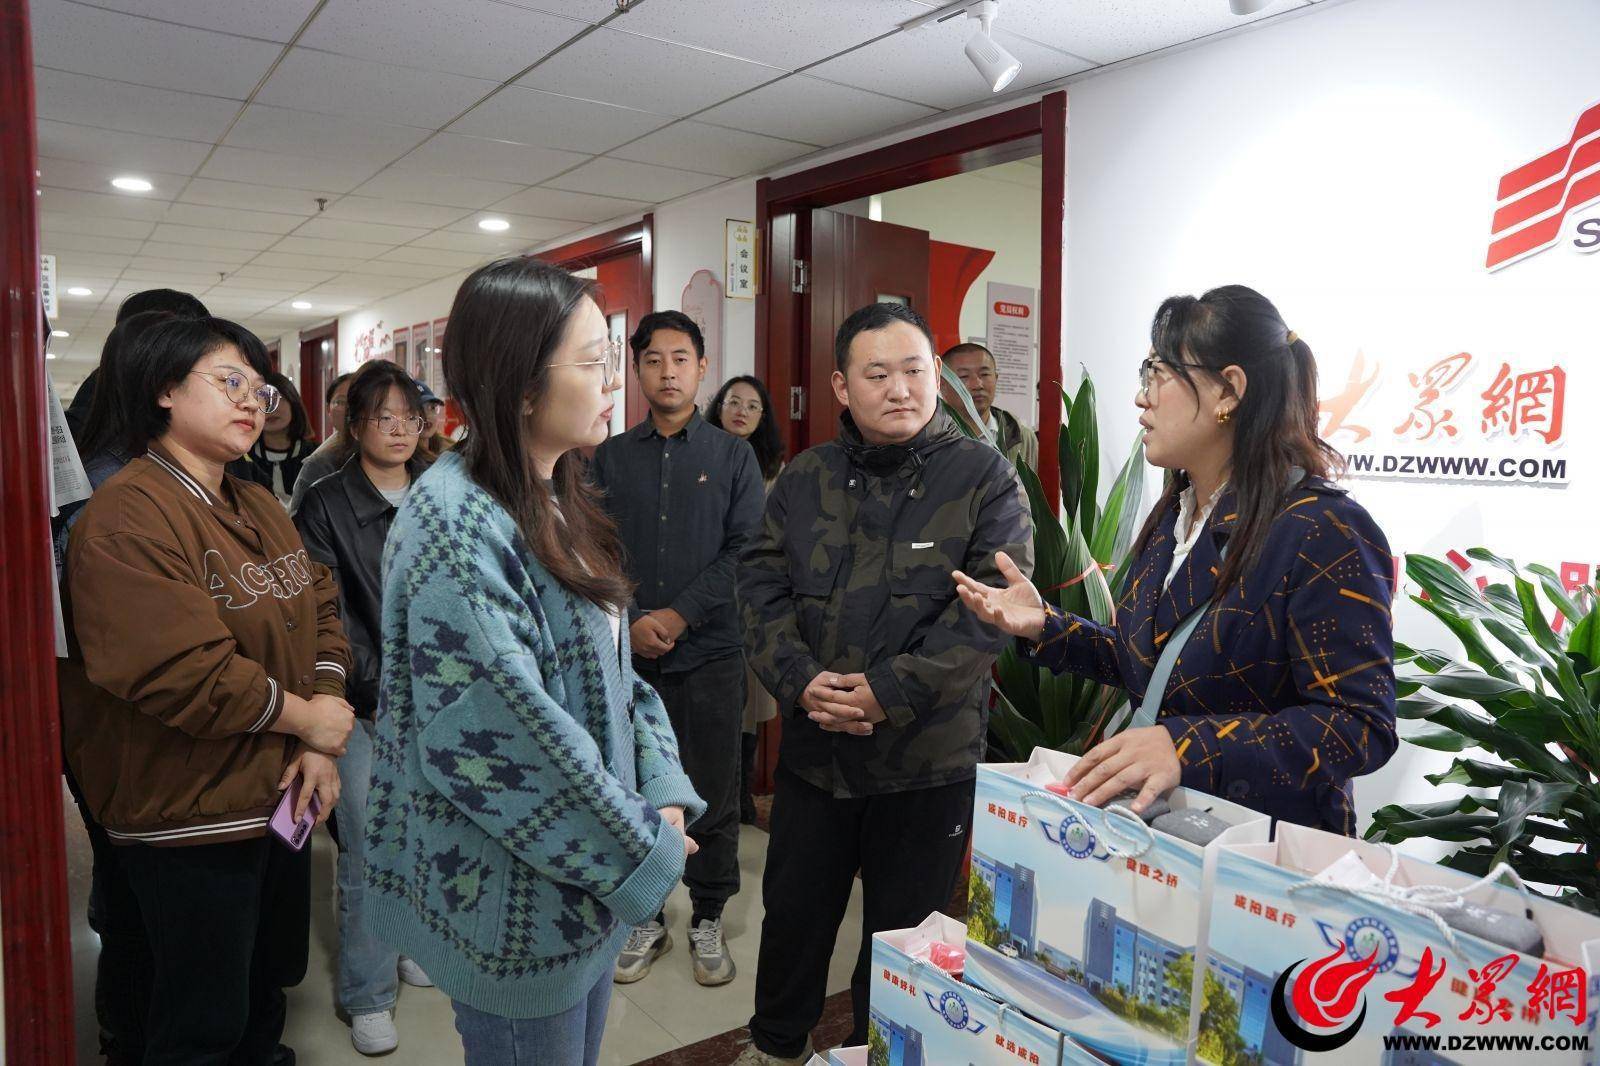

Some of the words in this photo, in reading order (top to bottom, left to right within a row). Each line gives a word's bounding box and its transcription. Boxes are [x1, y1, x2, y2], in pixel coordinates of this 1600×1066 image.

[740, 249, 748, 288] 会议室
[1126, 857, 1178, 888] 健康之桥
[995, 1034, 1039, 1065] 就选咸阳
